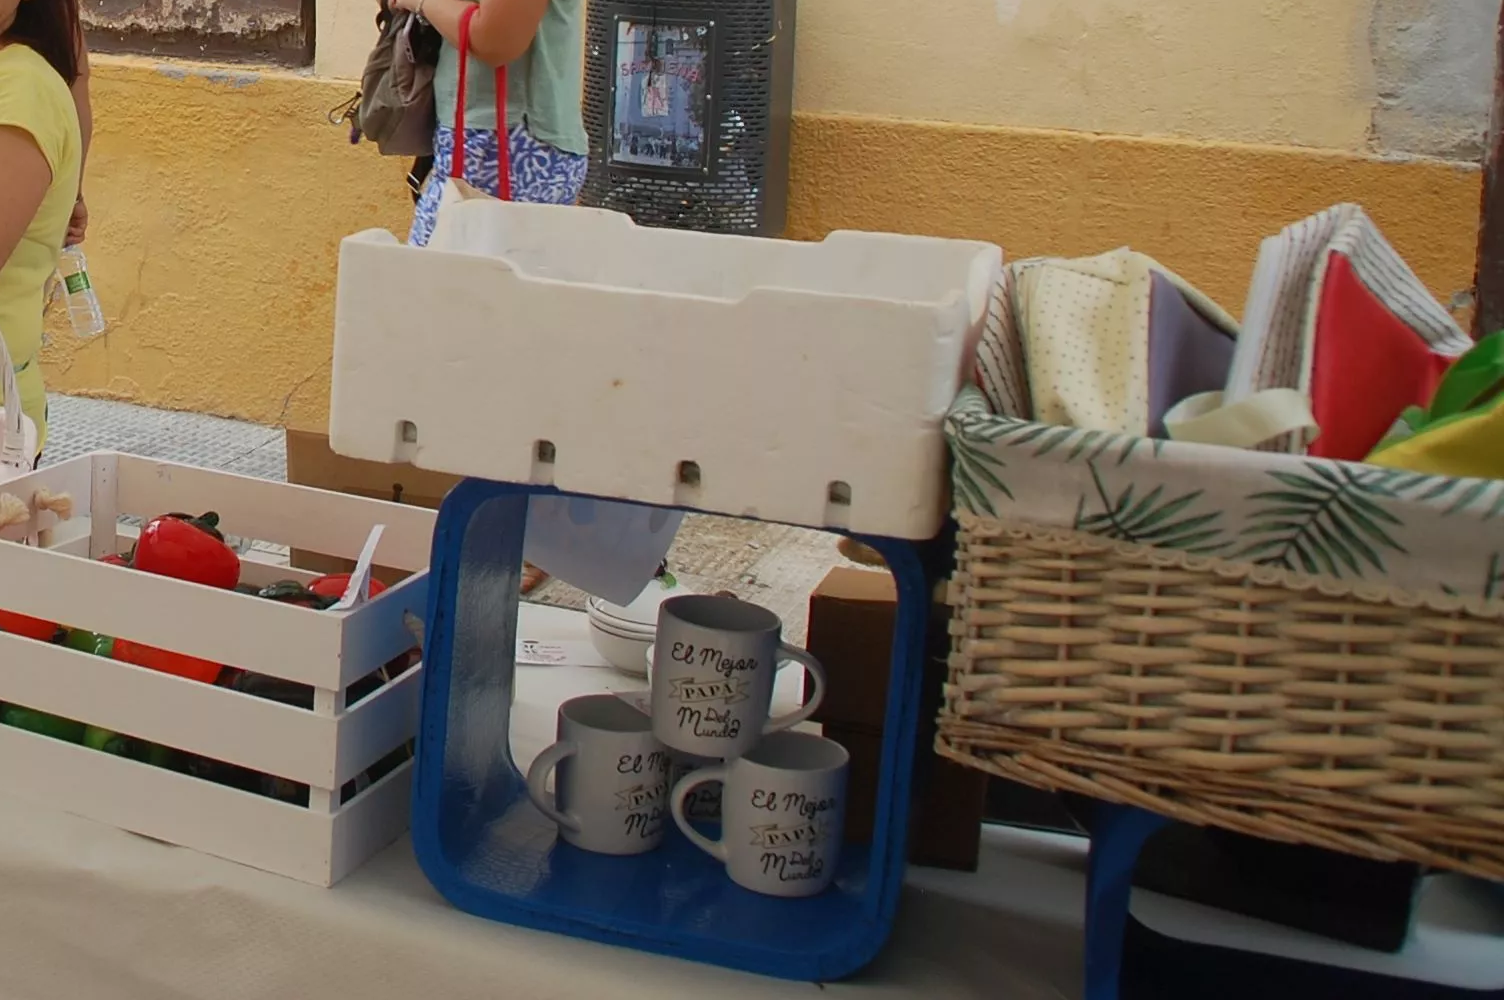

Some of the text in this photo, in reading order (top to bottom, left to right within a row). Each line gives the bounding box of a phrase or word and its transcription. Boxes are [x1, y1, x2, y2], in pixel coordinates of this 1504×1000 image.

[671, 641, 759, 679] El Mejor
[676, 706, 742, 739] Mundo
[703, 707, 732, 724] Del
[617, 754, 643, 774] El
[751, 788, 777, 812] El
[781, 791, 835, 821] Mejor
[759, 851, 825, 882] Mundo
[788, 850, 816, 867] Del
